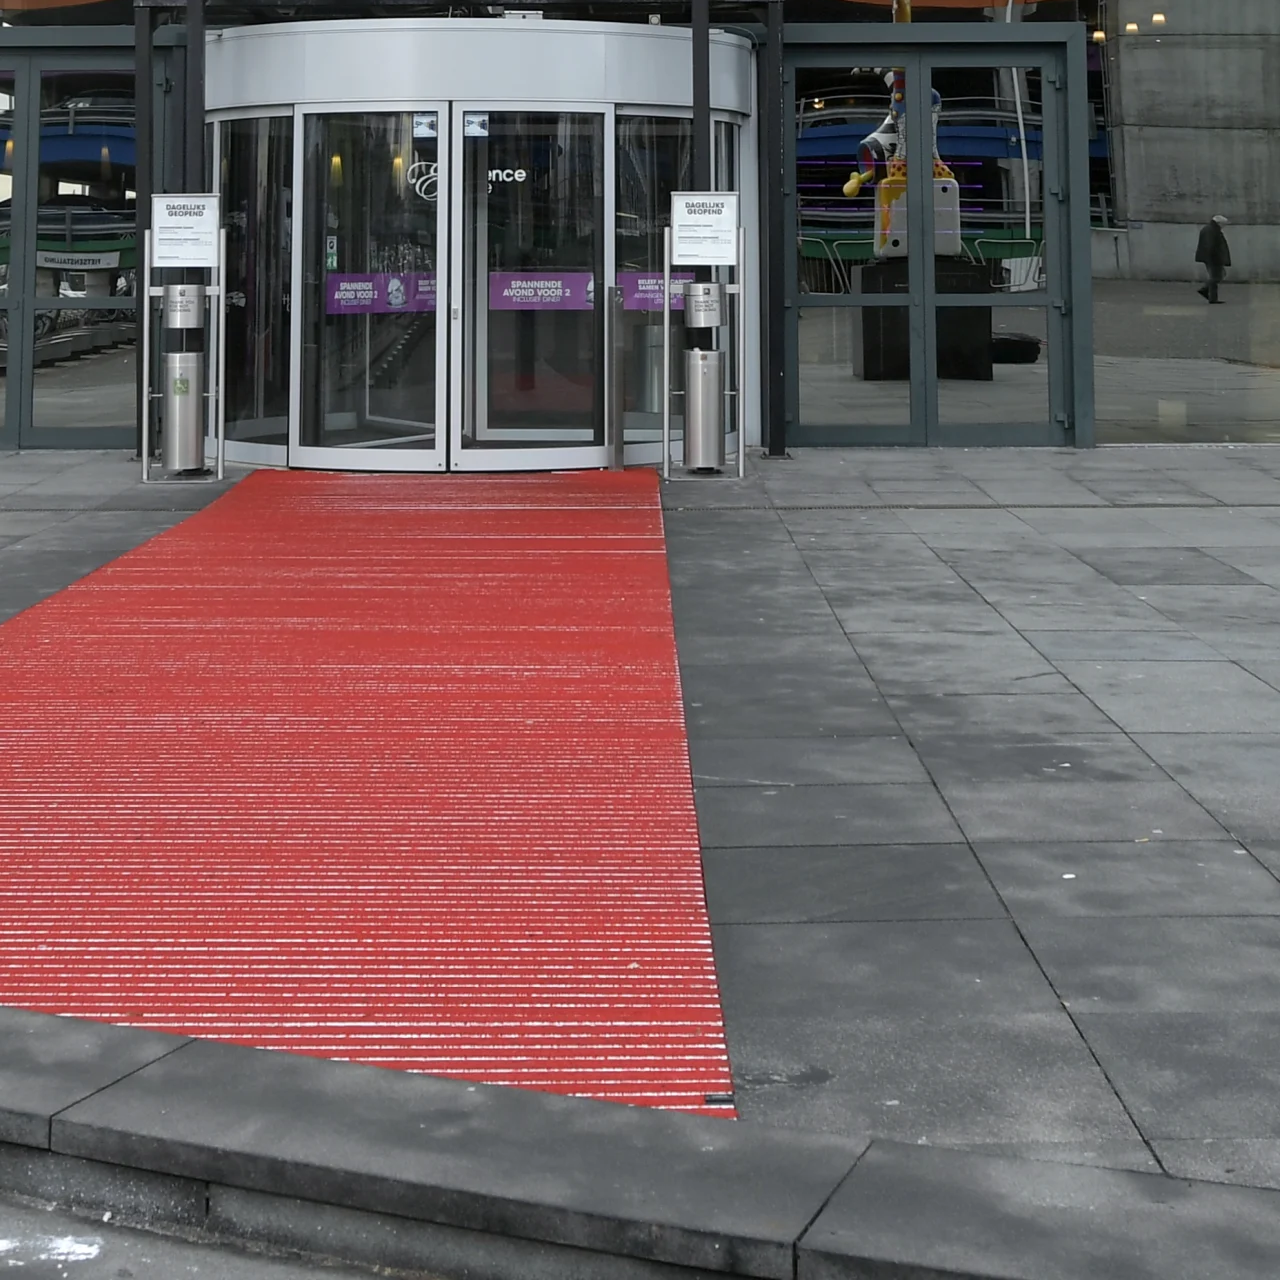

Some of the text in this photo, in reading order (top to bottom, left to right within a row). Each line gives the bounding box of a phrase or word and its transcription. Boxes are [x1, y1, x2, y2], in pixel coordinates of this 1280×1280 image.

[511, 280, 562, 288] SPANNENDE
[334, 291, 355, 299] AVOND
[356, 291, 373, 299] VOOR
[503, 288, 571, 296] AVOND VOOR 2
